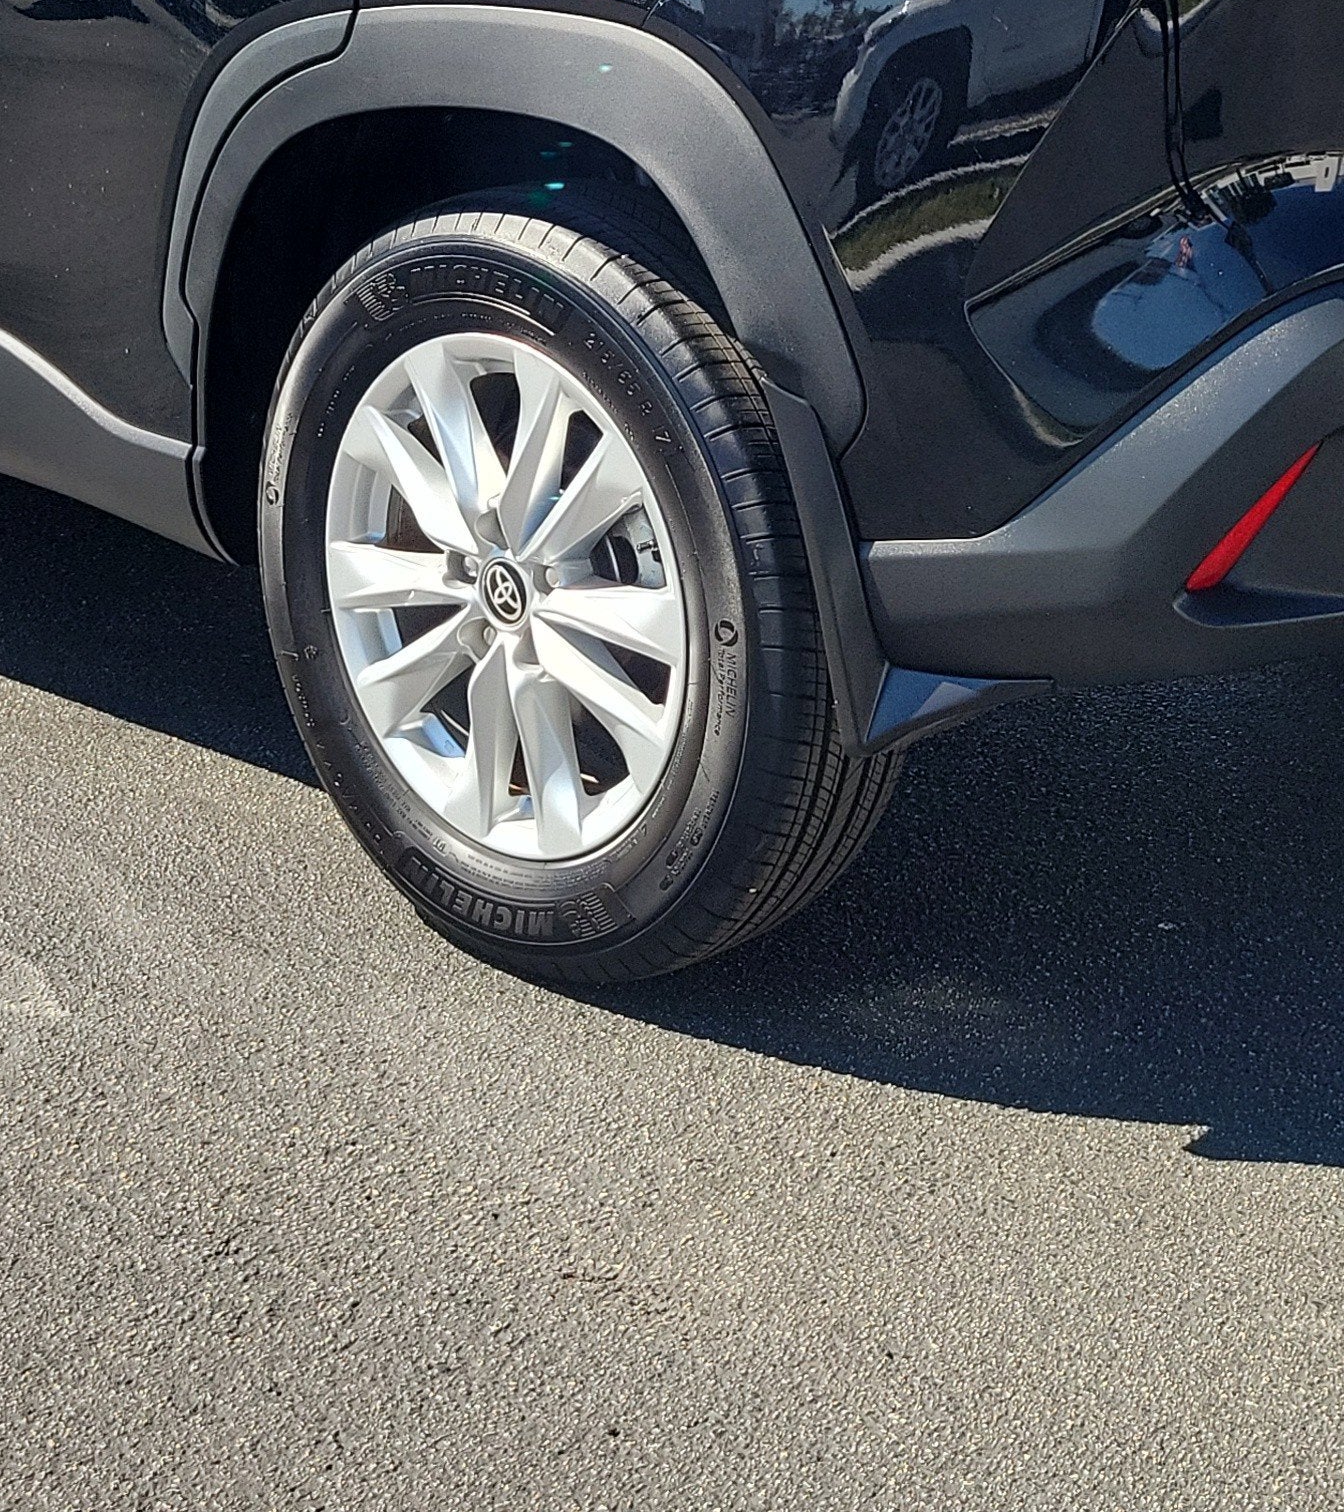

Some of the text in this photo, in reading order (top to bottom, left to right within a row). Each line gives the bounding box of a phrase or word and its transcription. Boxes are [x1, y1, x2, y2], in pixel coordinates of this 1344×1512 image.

[410, 264, 570, 331] MICHELIN
[725, 653, 737, 718] MICHELIN
[410, 856, 555, 936] MICHELIN
